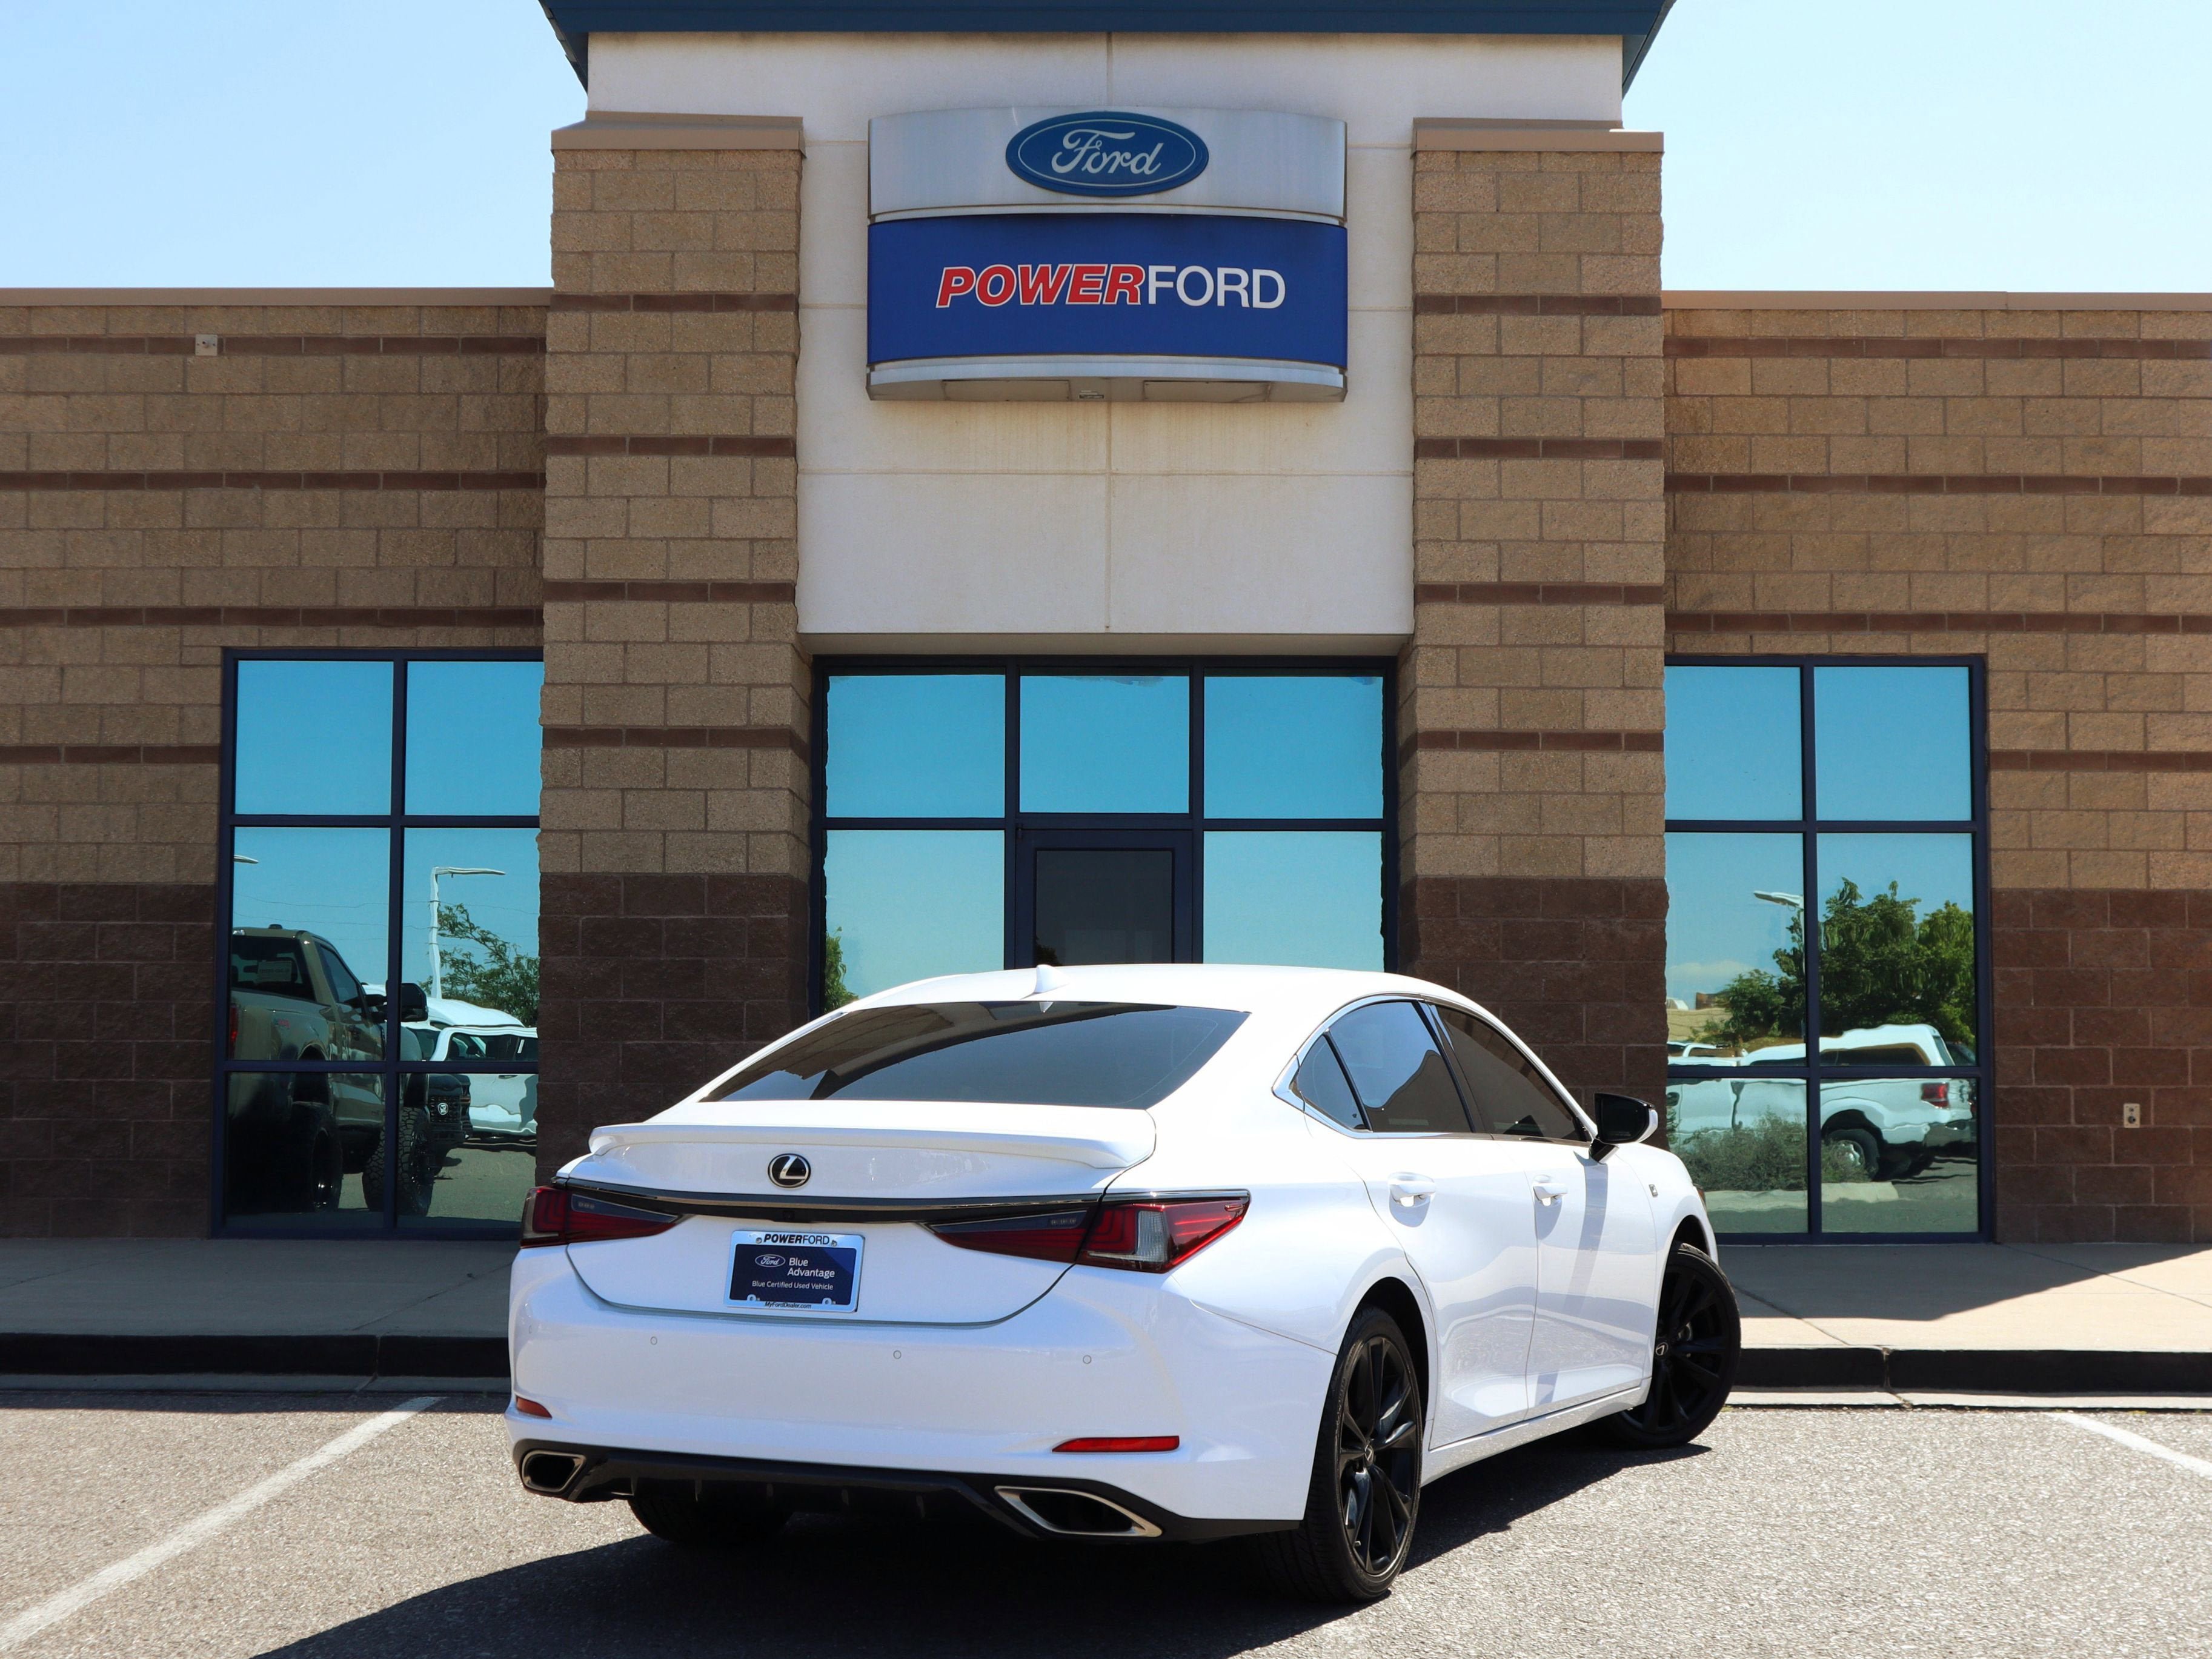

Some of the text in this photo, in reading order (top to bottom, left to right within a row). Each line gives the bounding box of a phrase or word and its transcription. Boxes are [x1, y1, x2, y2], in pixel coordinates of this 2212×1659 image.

[1051, 128, 1164, 175] Ford
[936, 264, 1286, 309] POWERFORD
[764, 1234, 829, 1245] POWERFORD
[760, 1256, 779, 1266] Ford
[789, 1257, 809, 1266] Blue
[788, 1268, 835, 1279] Advantage
[765, 1301, 812, 1309] MyFordDealer.com
